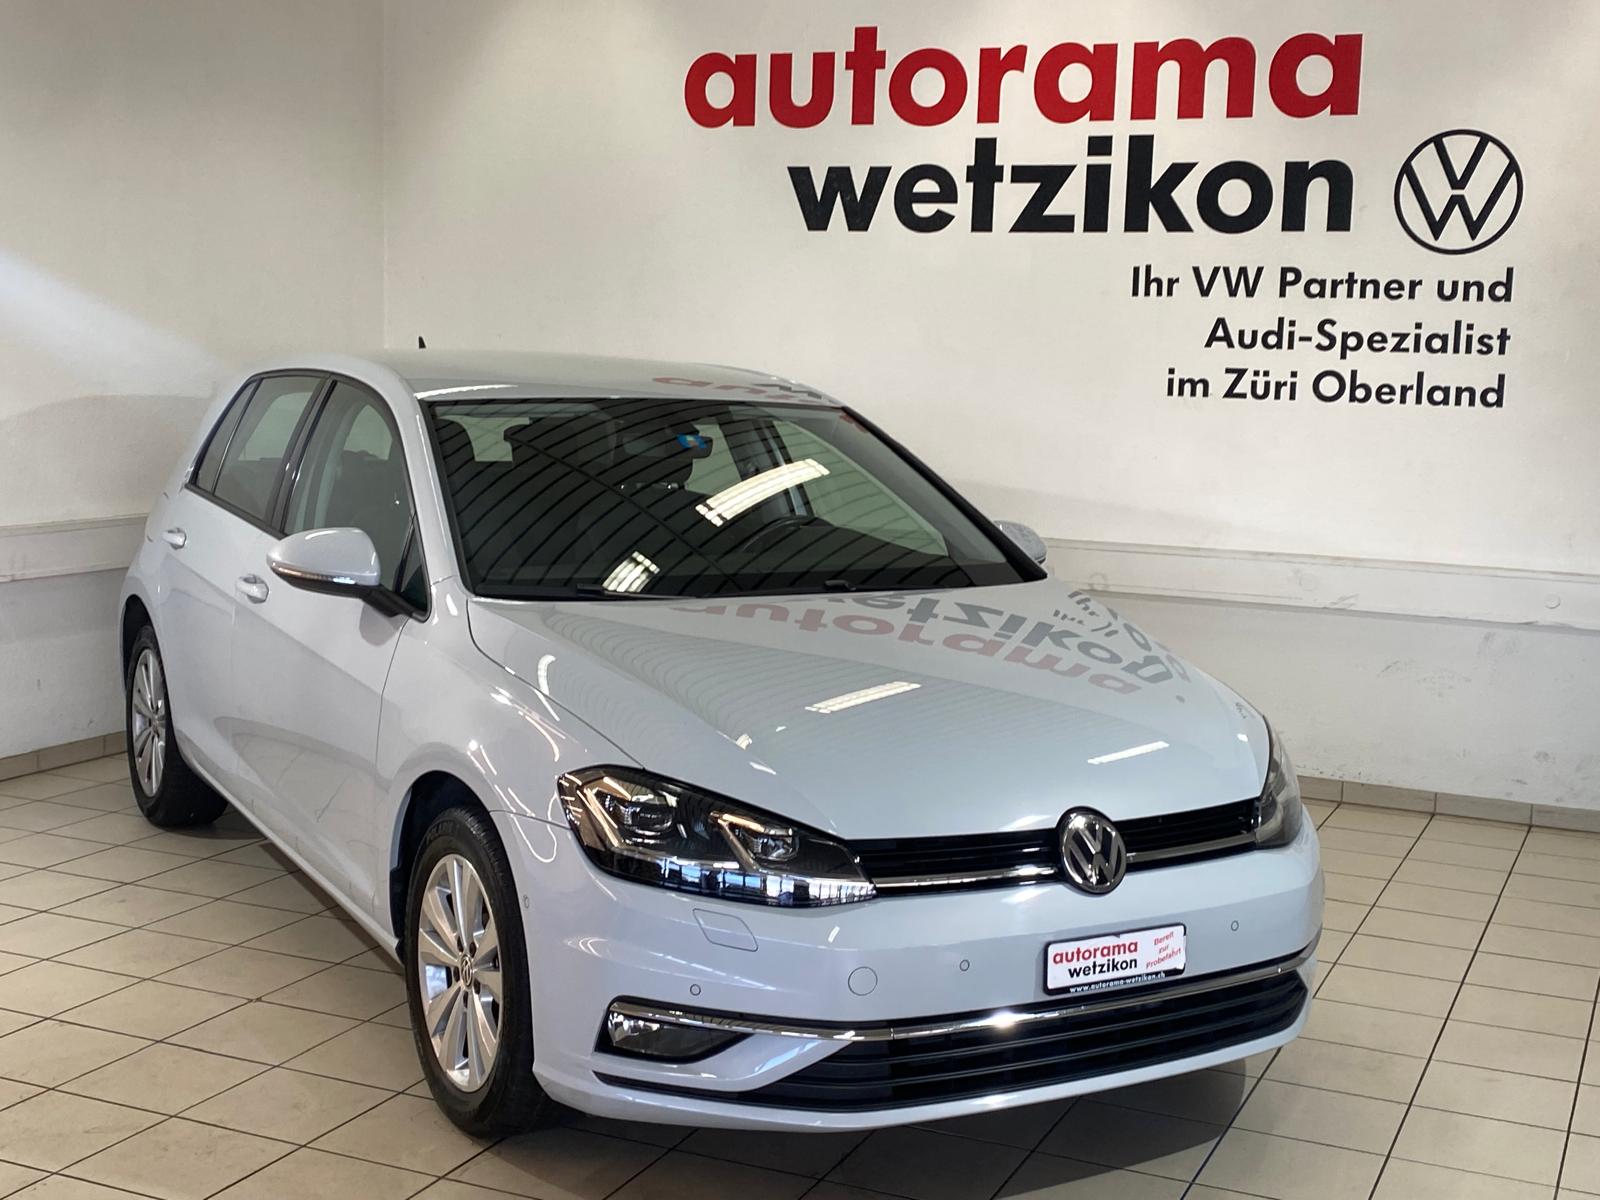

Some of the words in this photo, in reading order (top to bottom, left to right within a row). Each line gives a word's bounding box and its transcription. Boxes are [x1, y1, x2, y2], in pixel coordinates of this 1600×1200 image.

[685, 27, 1361, 128] autorama
[787, 135, 1354, 234] wetzikon
[1131, 265, 1180, 297] Ihr
[1192, 266, 1265, 298] VW
[1279, 266, 1423, 300] Partner
[1436, 267, 1514, 303] und
[1205, 317, 1511, 360] Audi-Spezialist
[1167, 367, 1210, 398] im
[1222, 368, 1298, 401] Züri
[1312, 370, 1506, 408] Oberland
[1053, 942, 1138, 964] autorama
[1154, 931, 1174, 946] Bereit
[1068, 958, 1138, 978] wetzikon
[1146, 948, 1181, 969] Probefahrt
[1070, 973, 1166, 993] www.autorama-wetzikon.ch
